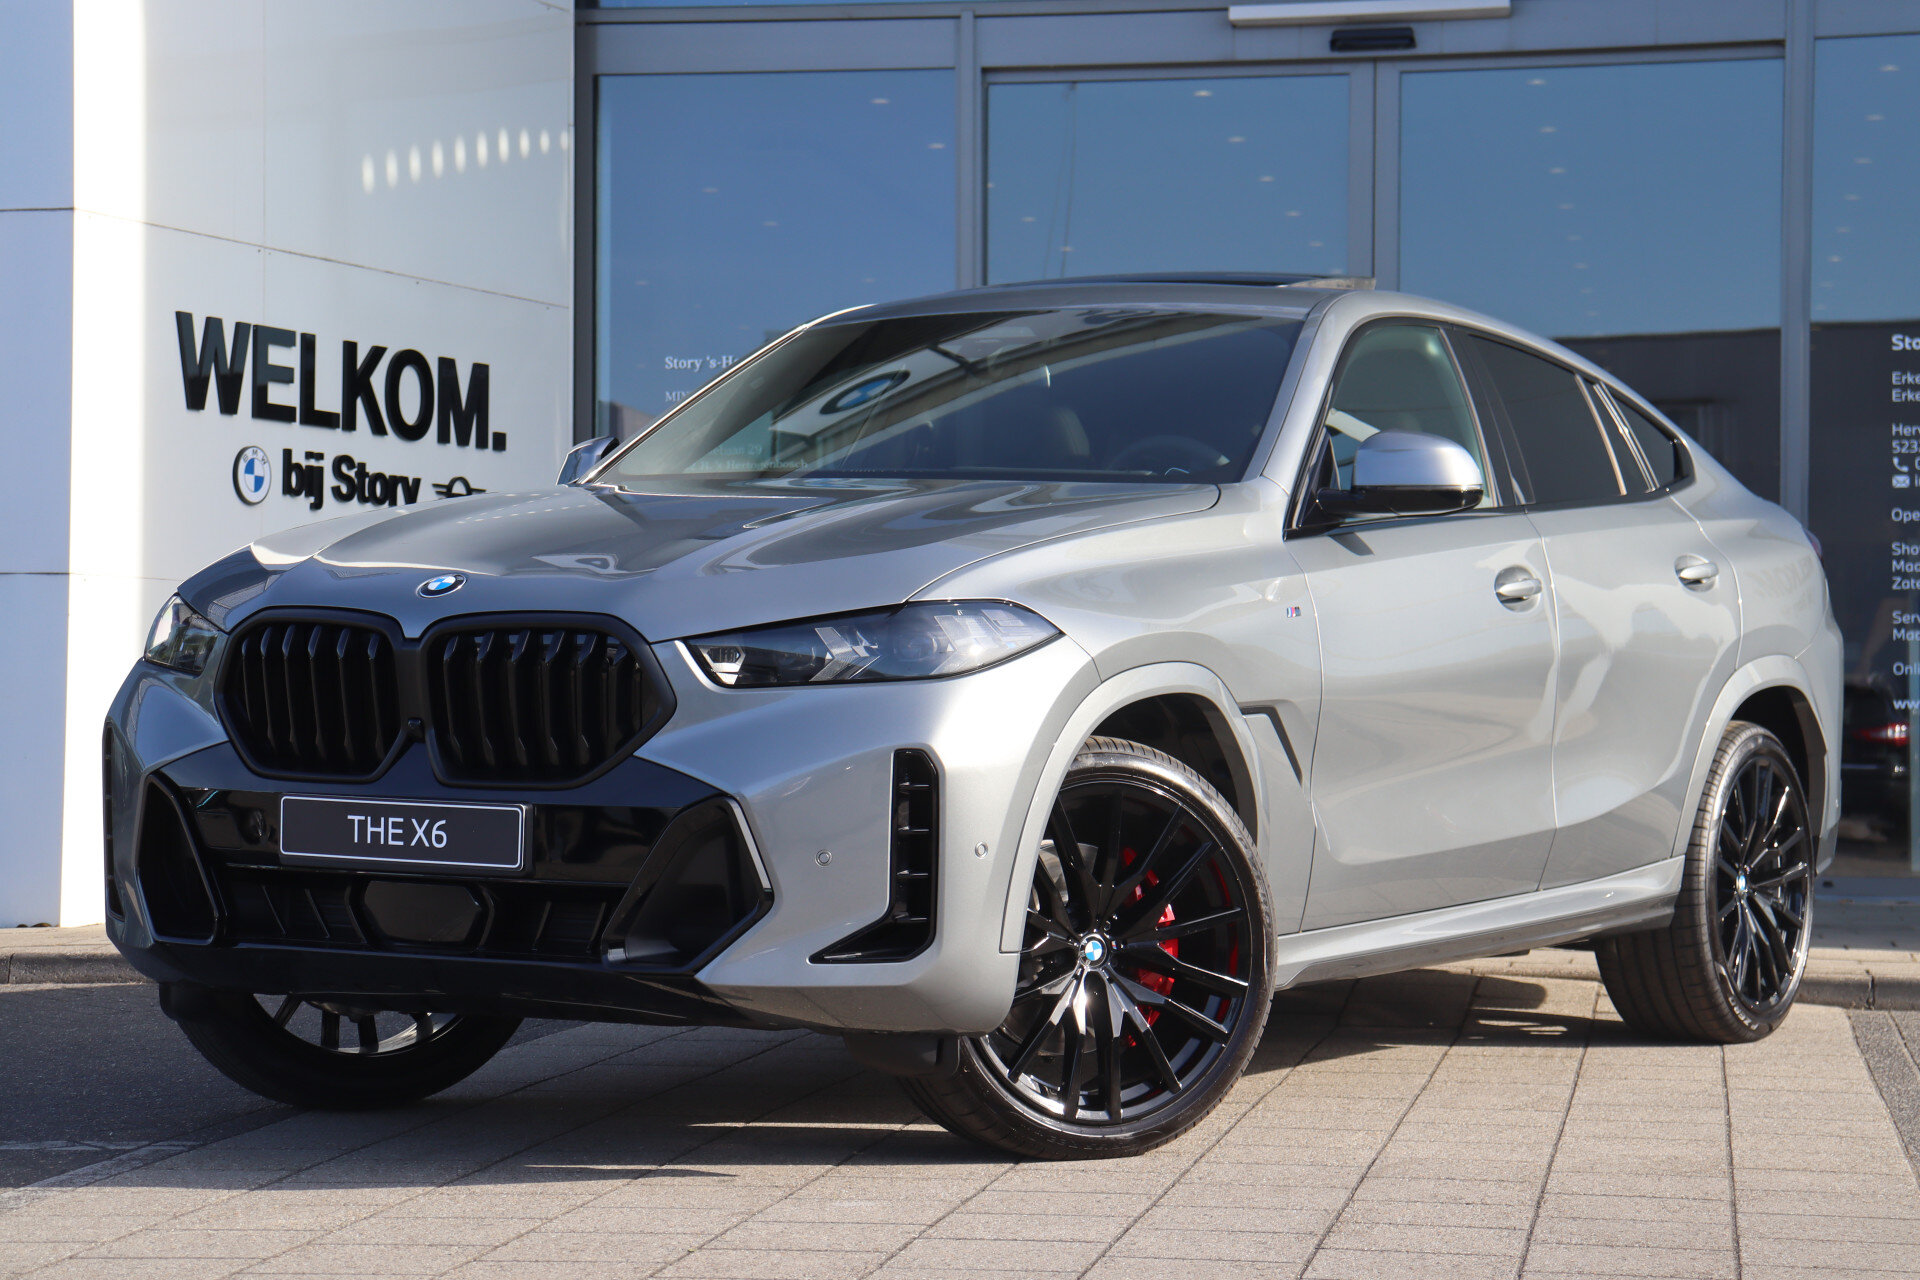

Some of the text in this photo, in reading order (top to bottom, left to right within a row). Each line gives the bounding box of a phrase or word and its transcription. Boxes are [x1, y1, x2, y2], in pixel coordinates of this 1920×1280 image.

[175, 310, 507, 452] WELKOM.
[664, 356, 703, 372] Story
[1891, 439, 1920, 454] 523
[282, 448, 324, 511] bij
[347, 814, 447, 849] THE X6
